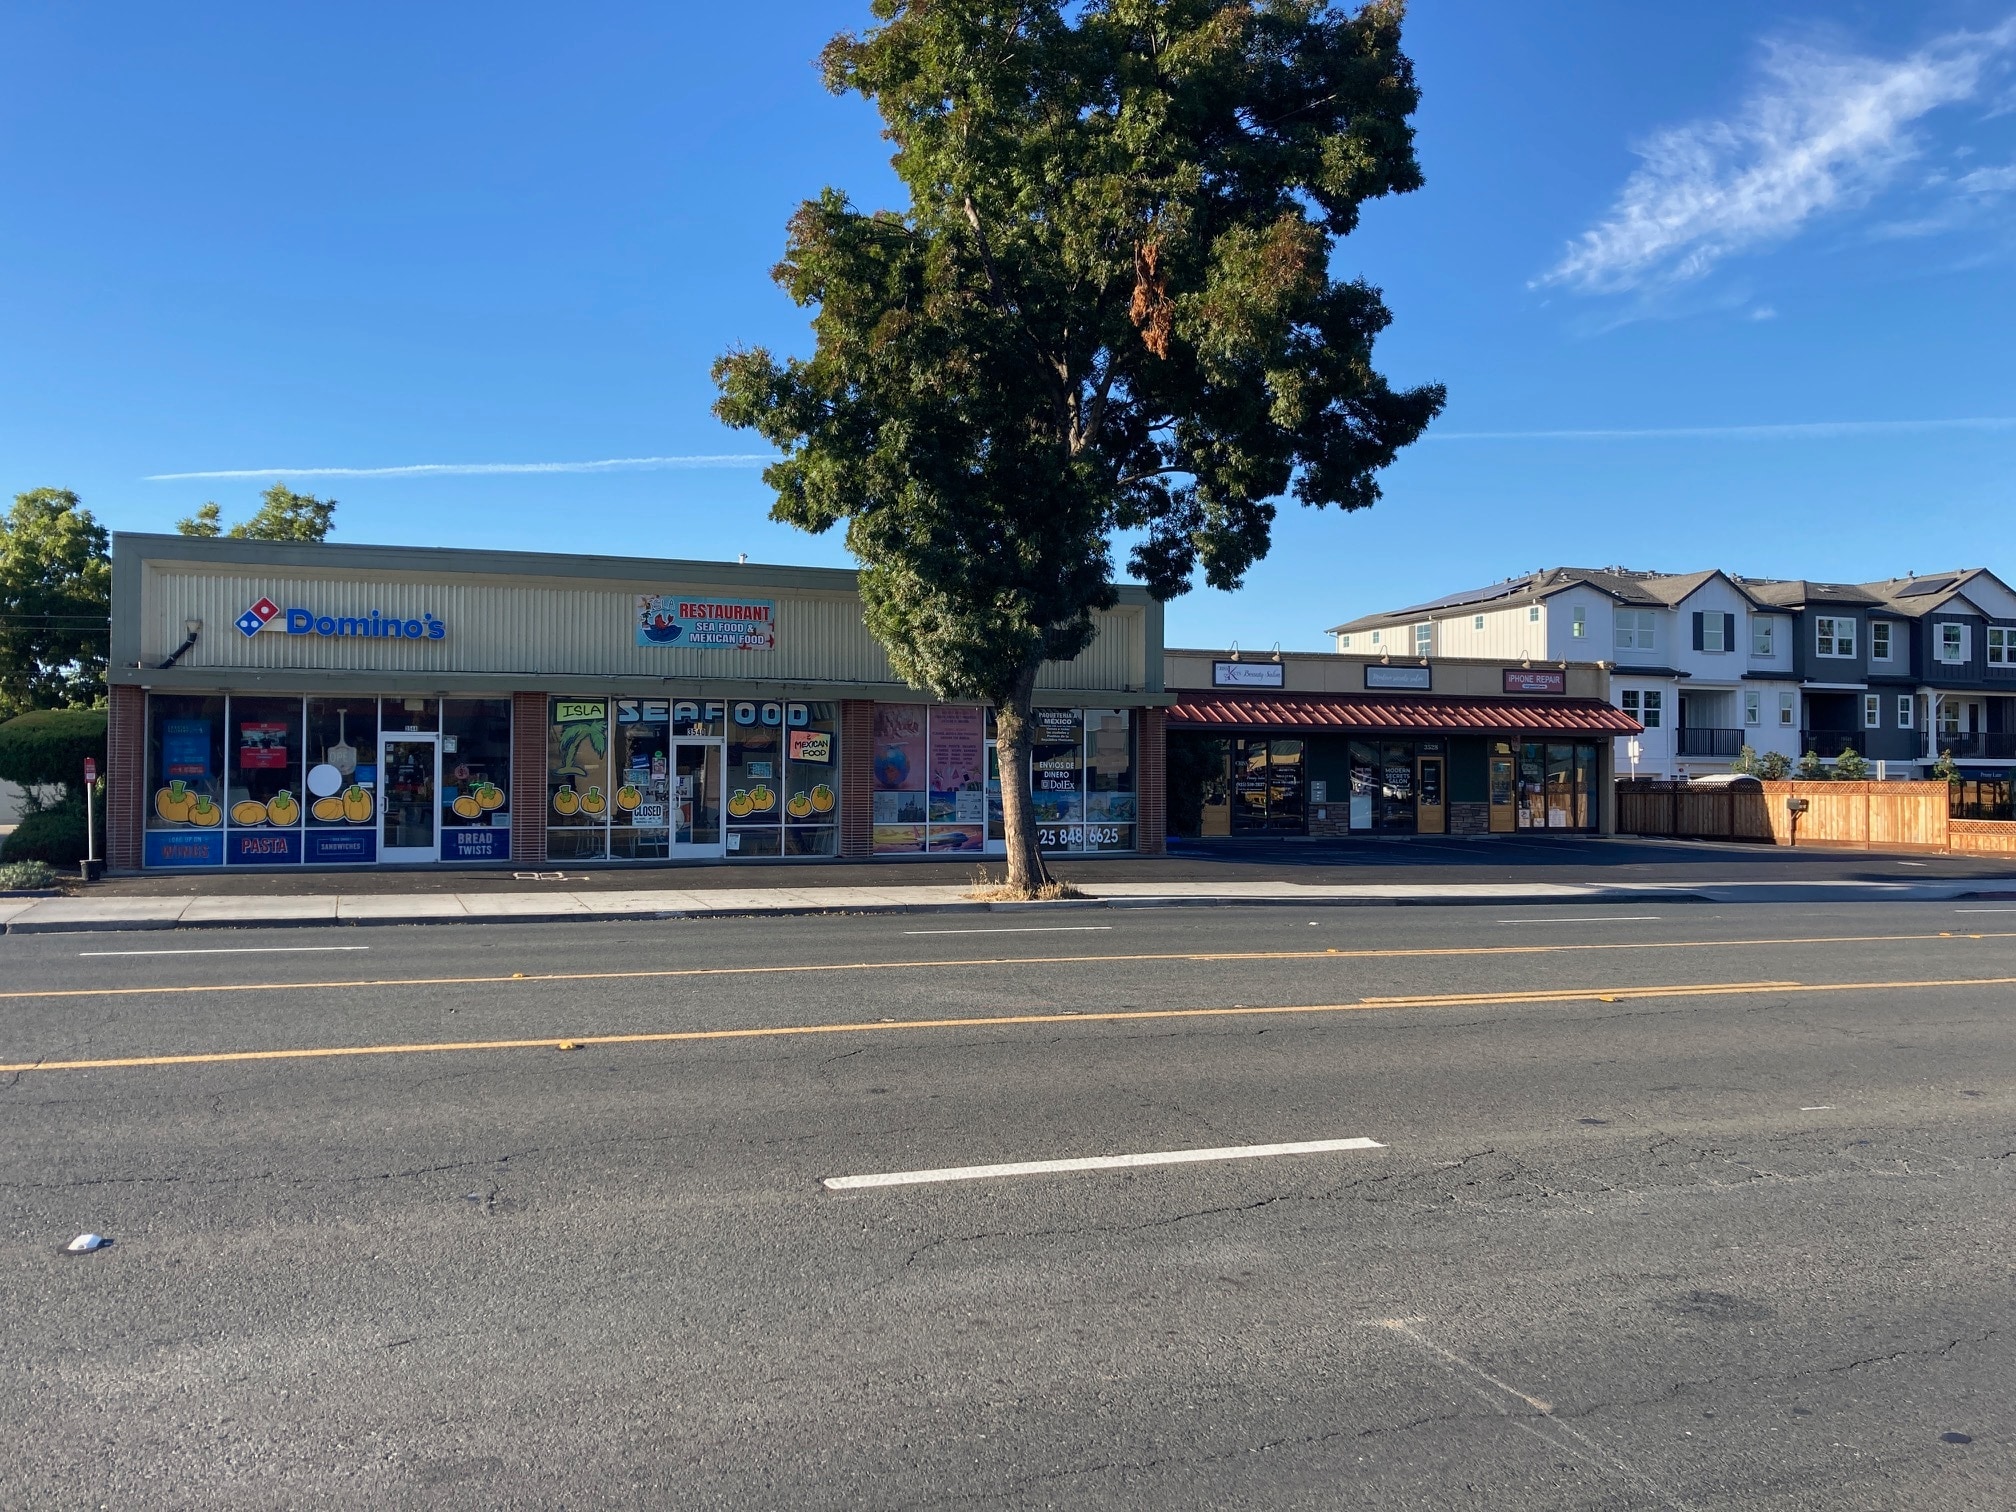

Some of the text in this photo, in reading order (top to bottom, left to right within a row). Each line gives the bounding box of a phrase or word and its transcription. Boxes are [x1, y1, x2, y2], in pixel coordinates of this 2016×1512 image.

[679, 603, 770, 621] RESTAURANT
[286, 608, 446, 640] Domino's
[696, 622, 754, 633] SEA FOOD &
[689, 633, 765, 645] MEXICAN FOOD
[1508, 674, 1560, 684] iPHONE REPAIR
[562, 704, 602, 718] ISLA
[794, 740, 829, 750] MEXICAN
[802, 749, 827, 758] FOOD
[1044, 771, 1070, 779] DINERO
[1050, 780, 1075, 790] DolEx
[634, 805, 662, 817] CLOSED
[457, 833, 493, 844] BREAD
[1037, 828, 1119, 846] 25 848 6625
[241, 837, 288, 854] PASTA
[320, 842, 361, 850] SANDWICHES
[458, 844, 492, 855] TWISTS
[162, 844, 209, 859] WINGS
